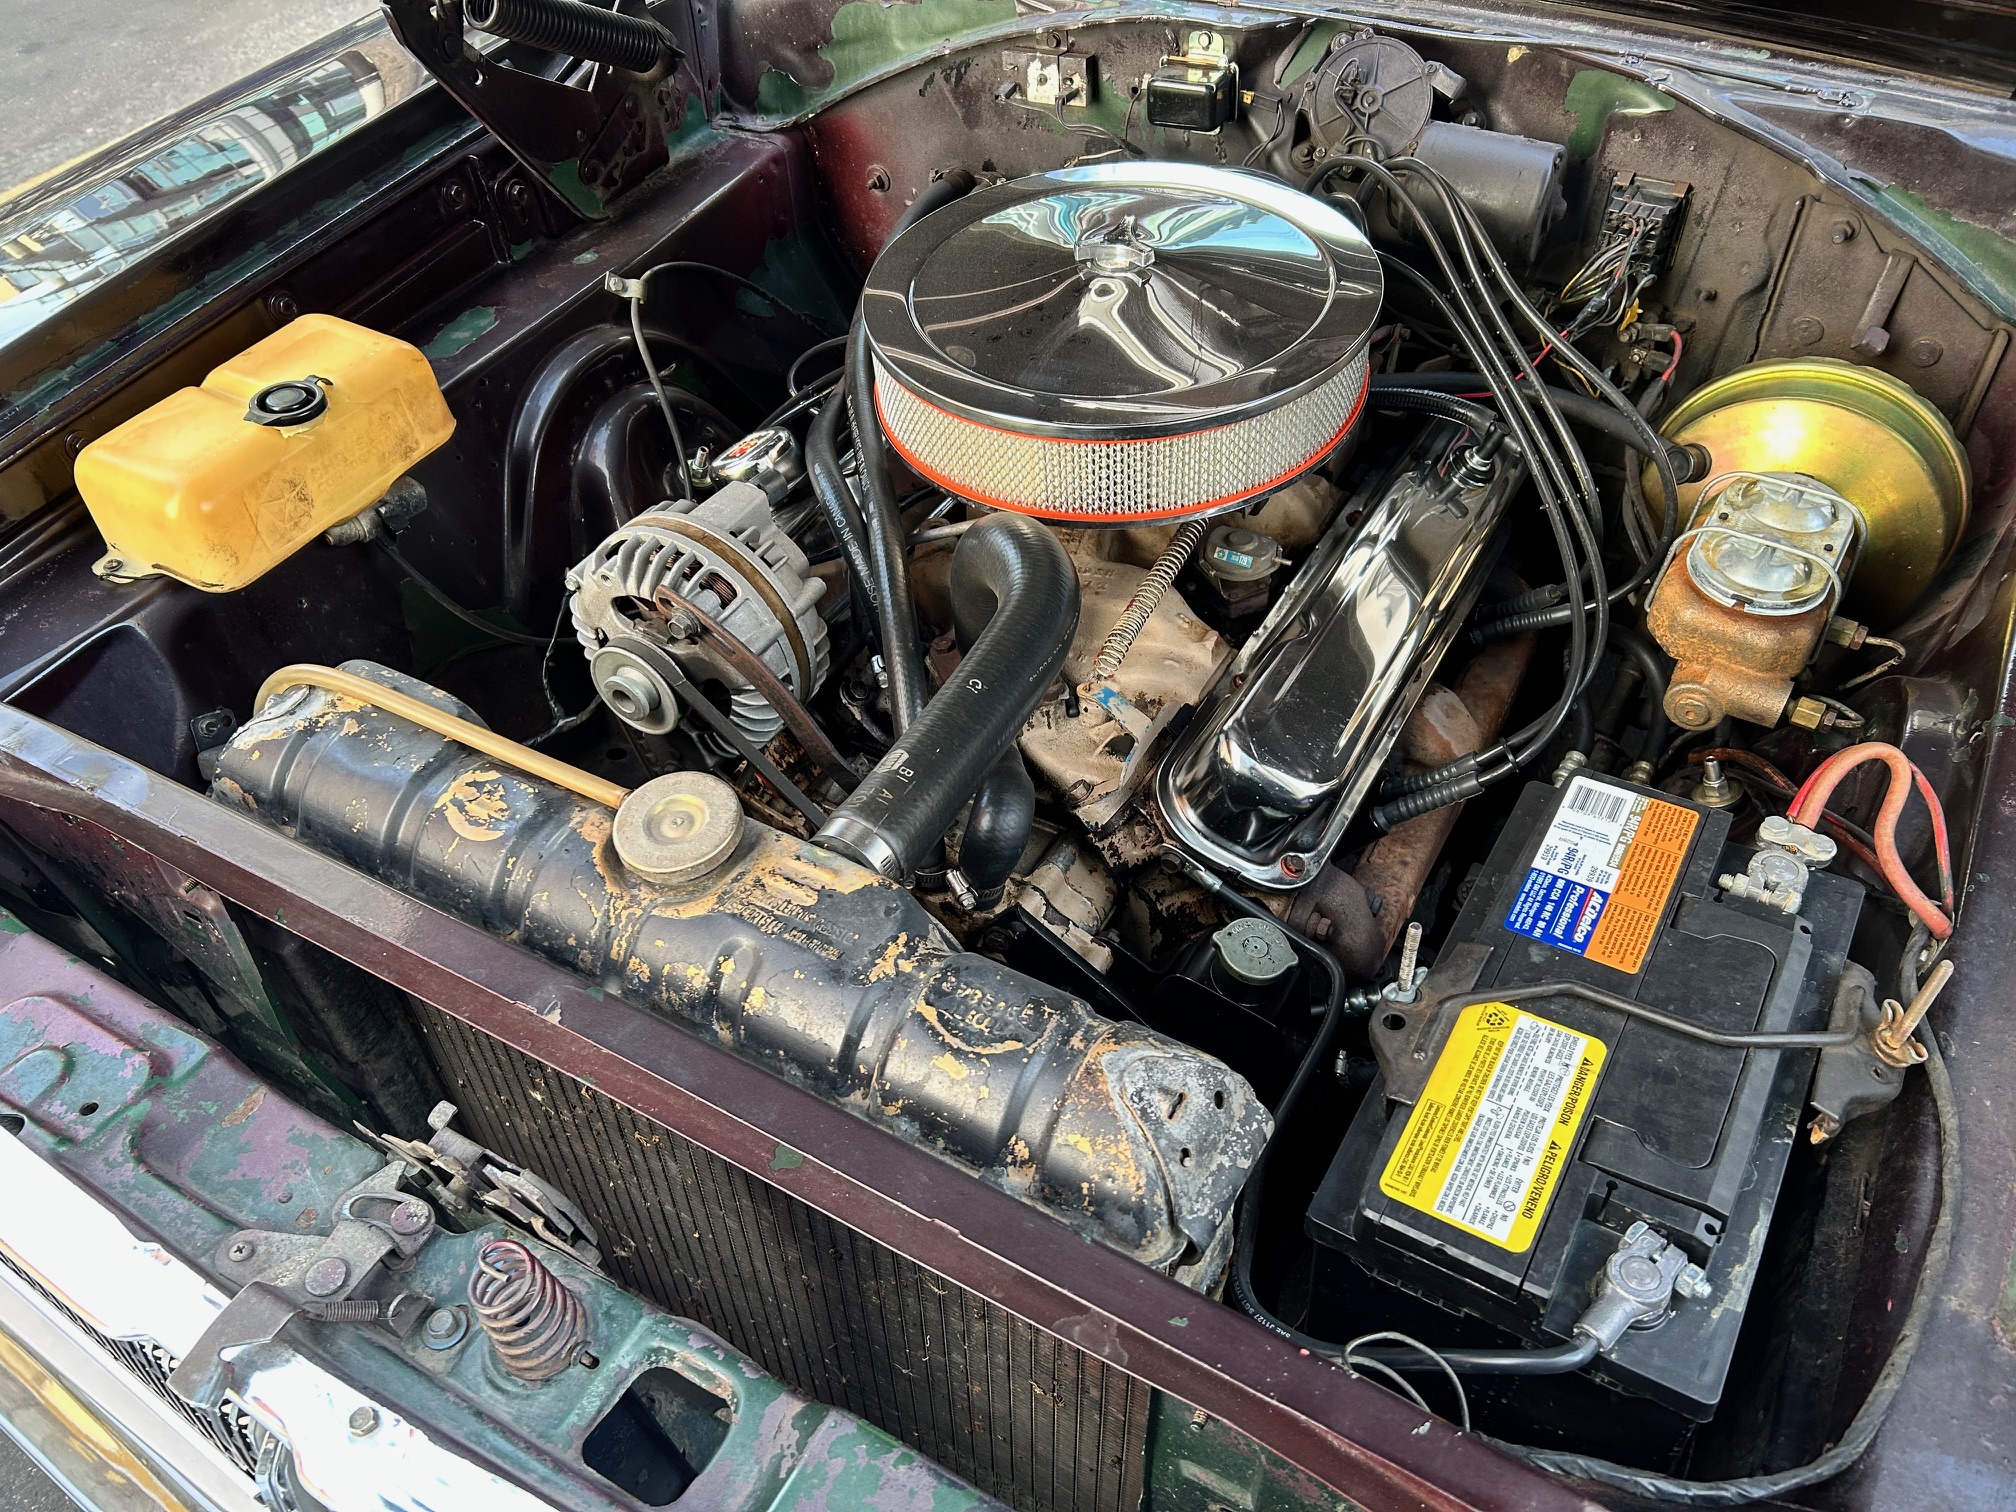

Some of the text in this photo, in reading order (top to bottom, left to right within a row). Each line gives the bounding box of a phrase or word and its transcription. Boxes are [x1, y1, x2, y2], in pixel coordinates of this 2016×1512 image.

[840, 527, 853, 541] IN
[848, 541, 870, 576] MADE
[1618, 813, 1642, 844] 94R/PG
[1539, 844, 1553, 860] 29939
[1556, 846, 1578, 875] 94R/PG
[1585, 865, 1598, 882] 29939
[1548, 887, 1561, 900] CCA
[1539, 910, 1551, 920] RC
[1552, 884, 1585, 939] Professional
[1572, 890, 1605, 944] ACDelco
[1531, 927, 1544, 938] AH
[1557, 1065, 1590, 1126] DANGER/POISON
[1521, 1157, 1530, 1166] NO
[1520, 1149, 1558, 1220] PELIGRO/VENENO
[1499, 1213, 1508, 1222] NO
[1253, 1313, 1275, 1329] J1127
